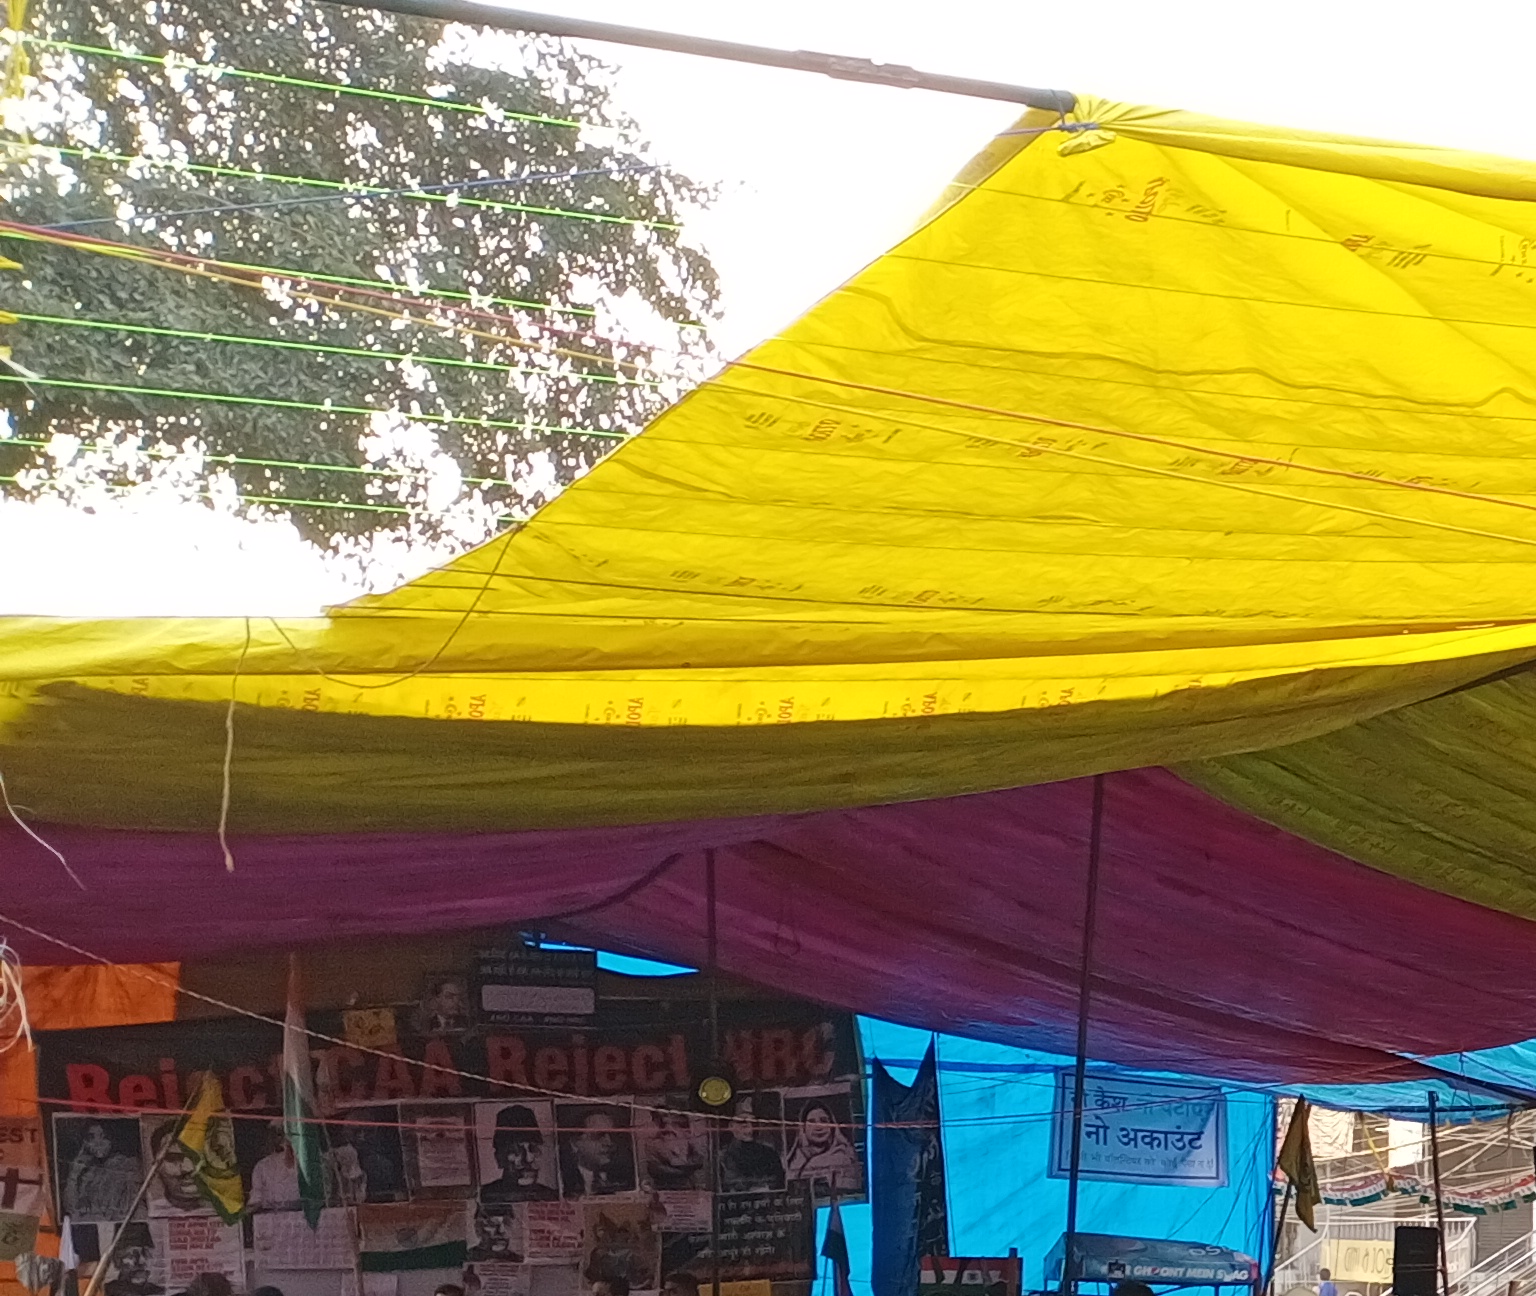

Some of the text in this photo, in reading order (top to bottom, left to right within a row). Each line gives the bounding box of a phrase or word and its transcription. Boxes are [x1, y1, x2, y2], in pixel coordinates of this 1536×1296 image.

[66, 1052, 300, 1114] Rejct
[1084, 1115, 1205, 1152] नो अकाउंट
